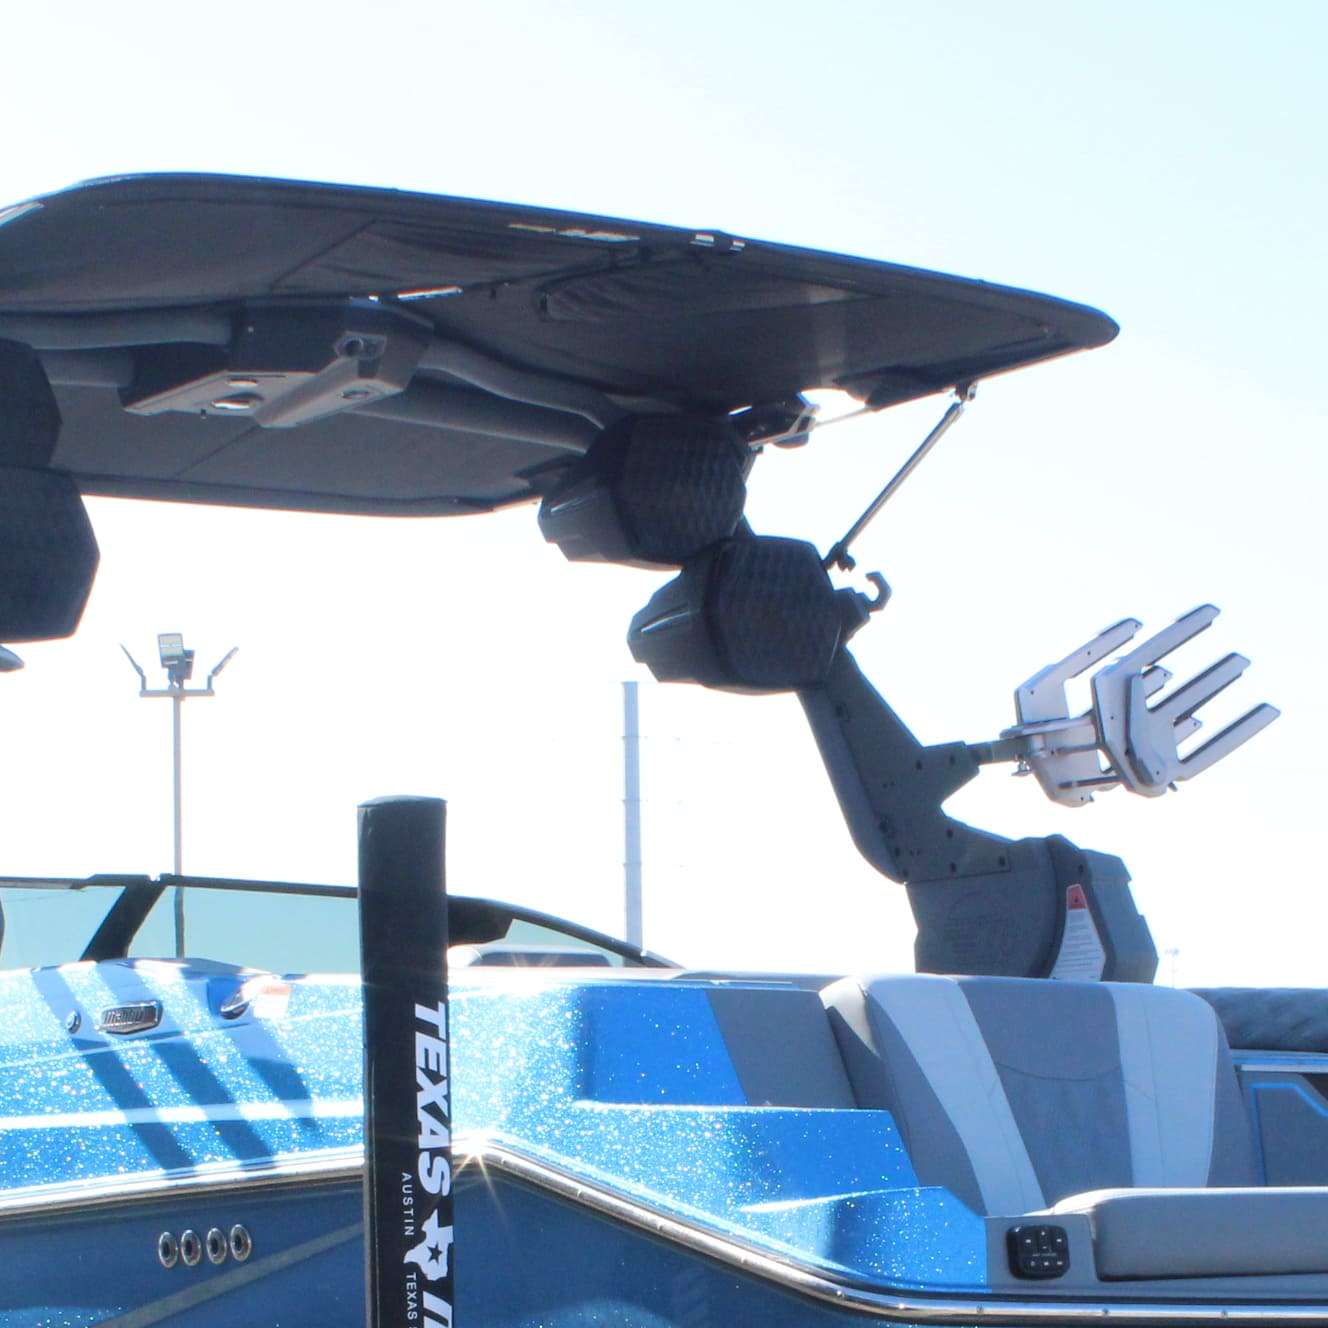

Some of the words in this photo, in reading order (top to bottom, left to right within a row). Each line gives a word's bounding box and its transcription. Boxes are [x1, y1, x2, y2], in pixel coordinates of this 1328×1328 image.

[415, 1001, 452, 1197] TEXAS
[402, 1172, 415, 1236] AUSTIN
[406, 1272, 418, 1321] TEXAS
